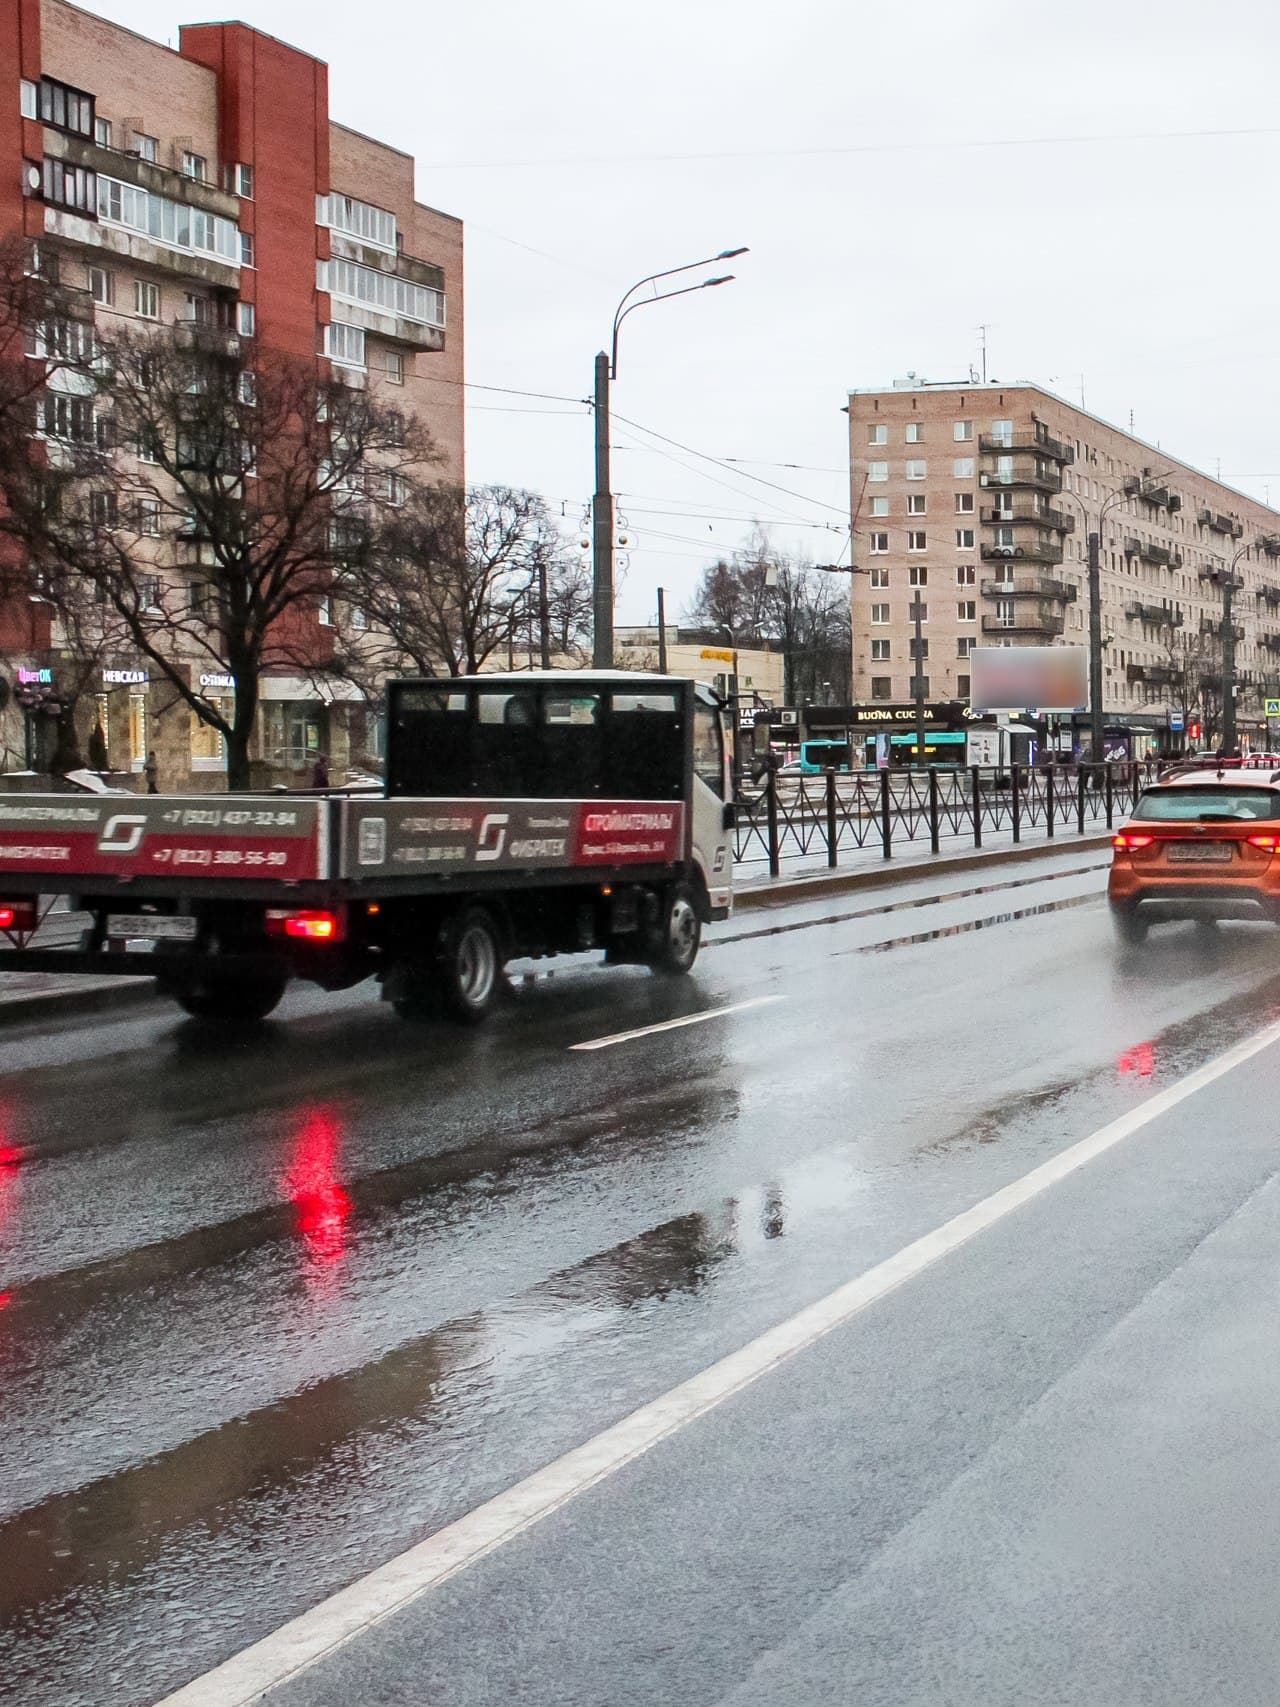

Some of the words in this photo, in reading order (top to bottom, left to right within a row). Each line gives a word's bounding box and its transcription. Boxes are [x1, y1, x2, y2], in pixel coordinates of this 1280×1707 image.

[102, 669, 146, 683] НЕВСКАЯ
[857, 709, 893, 721] BUONA
[585, 809, 673, 831] СТРОЙМАТЕРИАЛЫ
